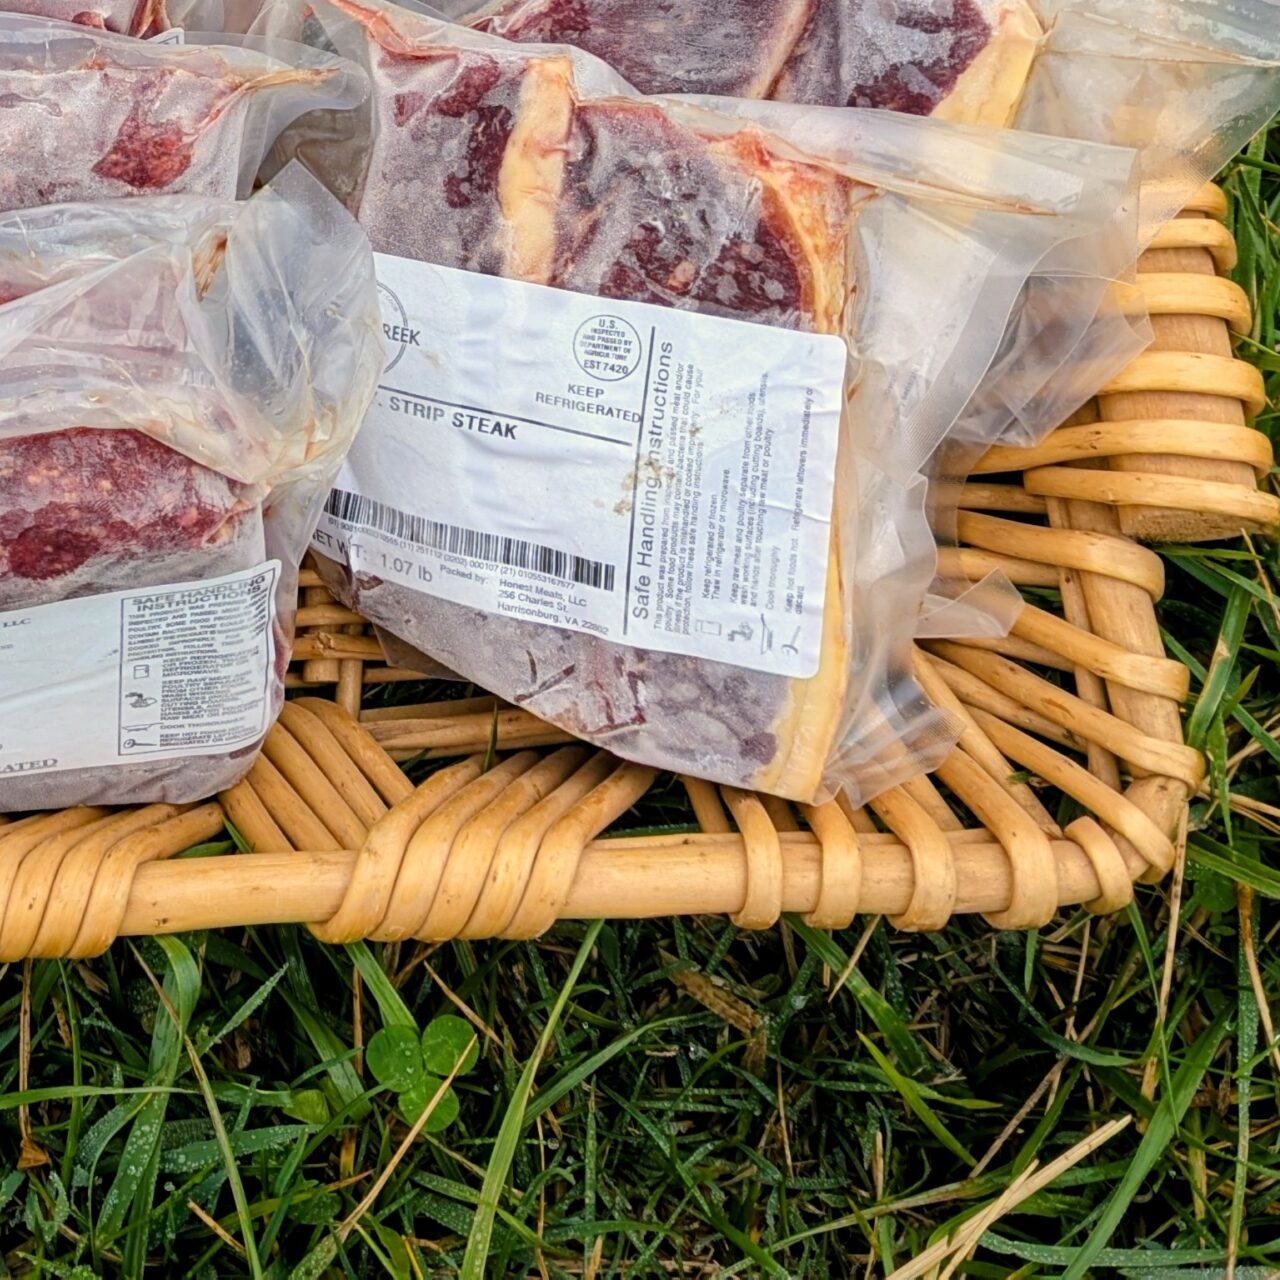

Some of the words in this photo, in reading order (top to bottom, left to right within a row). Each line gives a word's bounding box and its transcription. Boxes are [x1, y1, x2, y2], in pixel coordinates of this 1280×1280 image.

[380, 323, 422, 346] REEK
[598, 318, 619, 329] U.S.
[583, 359, 601, 370] EST
[602, 362, 628, 374] 7420
[567, 383, 605, 398] KEEP
[645, 340, 674, 467] Instructions
[388, 396, 445, 422] STRIP
[451, 411, 518, 440] STEAK
[534, 391, 641, 423] REFRIGERATED
[636, 475, 663, 567] Handling
[702, 530, 715, 576] refrigerated
[379, 554, 412, 576] 1.07
[416, 565, 434, 583] lb
[439, 563, 472, 580] Packed
[136, 585, 263, 613] INSTRUCTIONS
[499, 578, 532, 593] Honest
[567, 595, 587, 607] LLC
[516, 593, 555, 609] Charles
[632, 573, 652, 619] Safe
[2, 617, 31, 629] LLC
[497, 601, 562, 623] Harrisonburg,
[563, 616, 579, 627] VA
